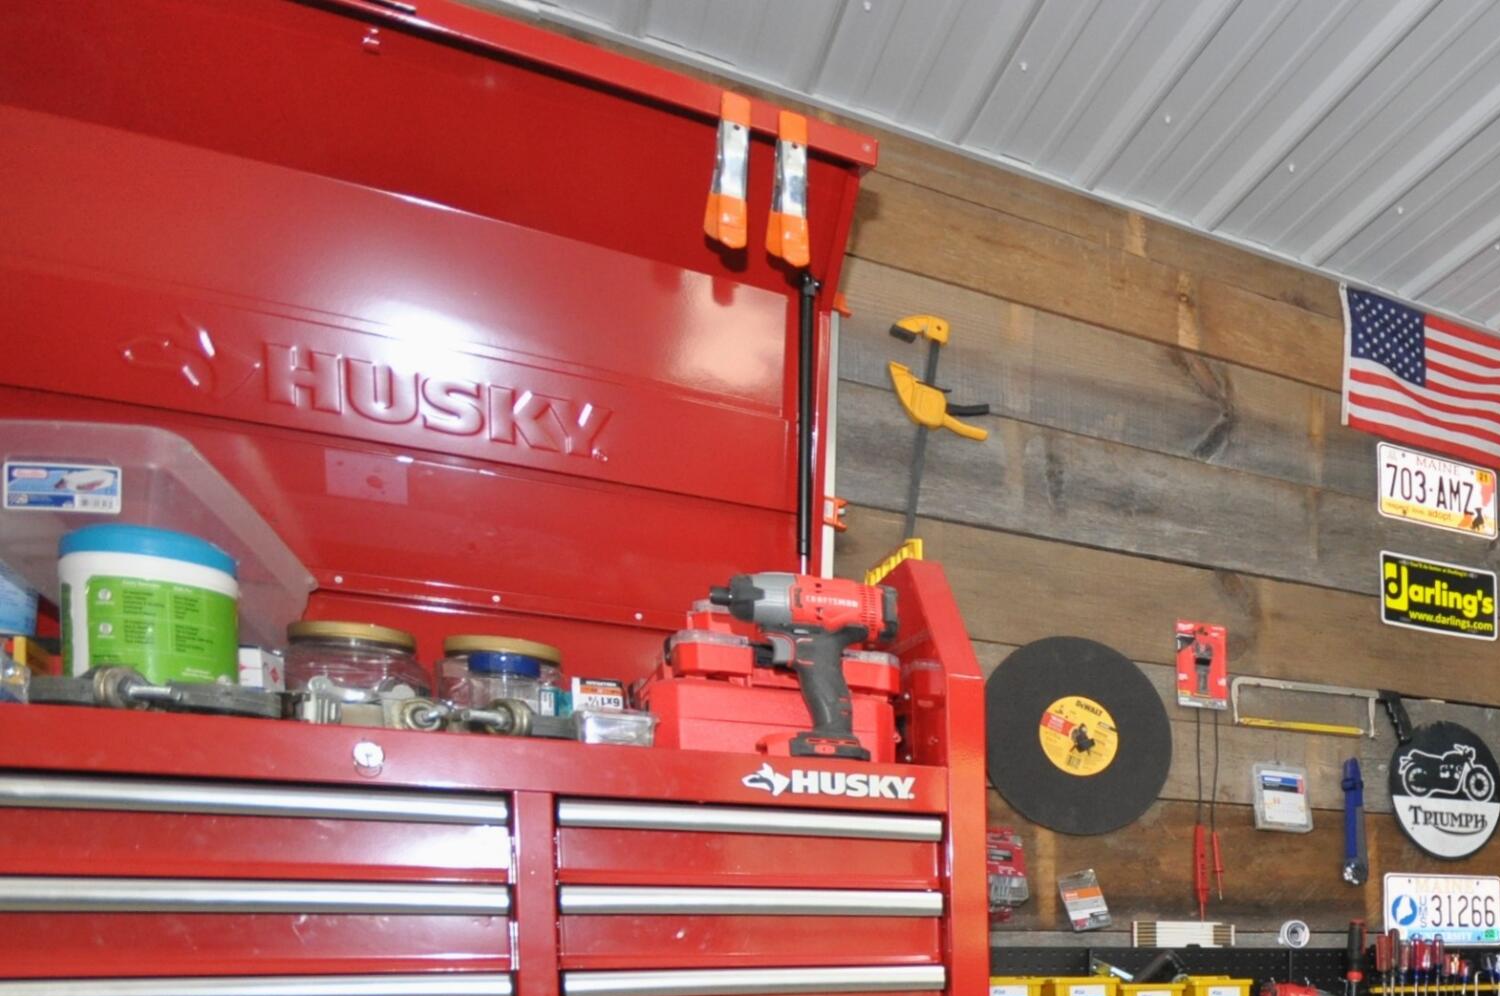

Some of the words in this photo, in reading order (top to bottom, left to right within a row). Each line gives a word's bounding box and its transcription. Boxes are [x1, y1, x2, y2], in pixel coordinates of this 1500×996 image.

[263, 342, 612, 460] HUSKY
[1416, 456, 1461, 477] MAINE
[1409, 610, 1493, 632] www.darlings.com
[791, 769, 914, 799] HUSKY
[1409, 804, 1488, 831] TRIUMPH
[1431, 894, 1496, 928] 31266
